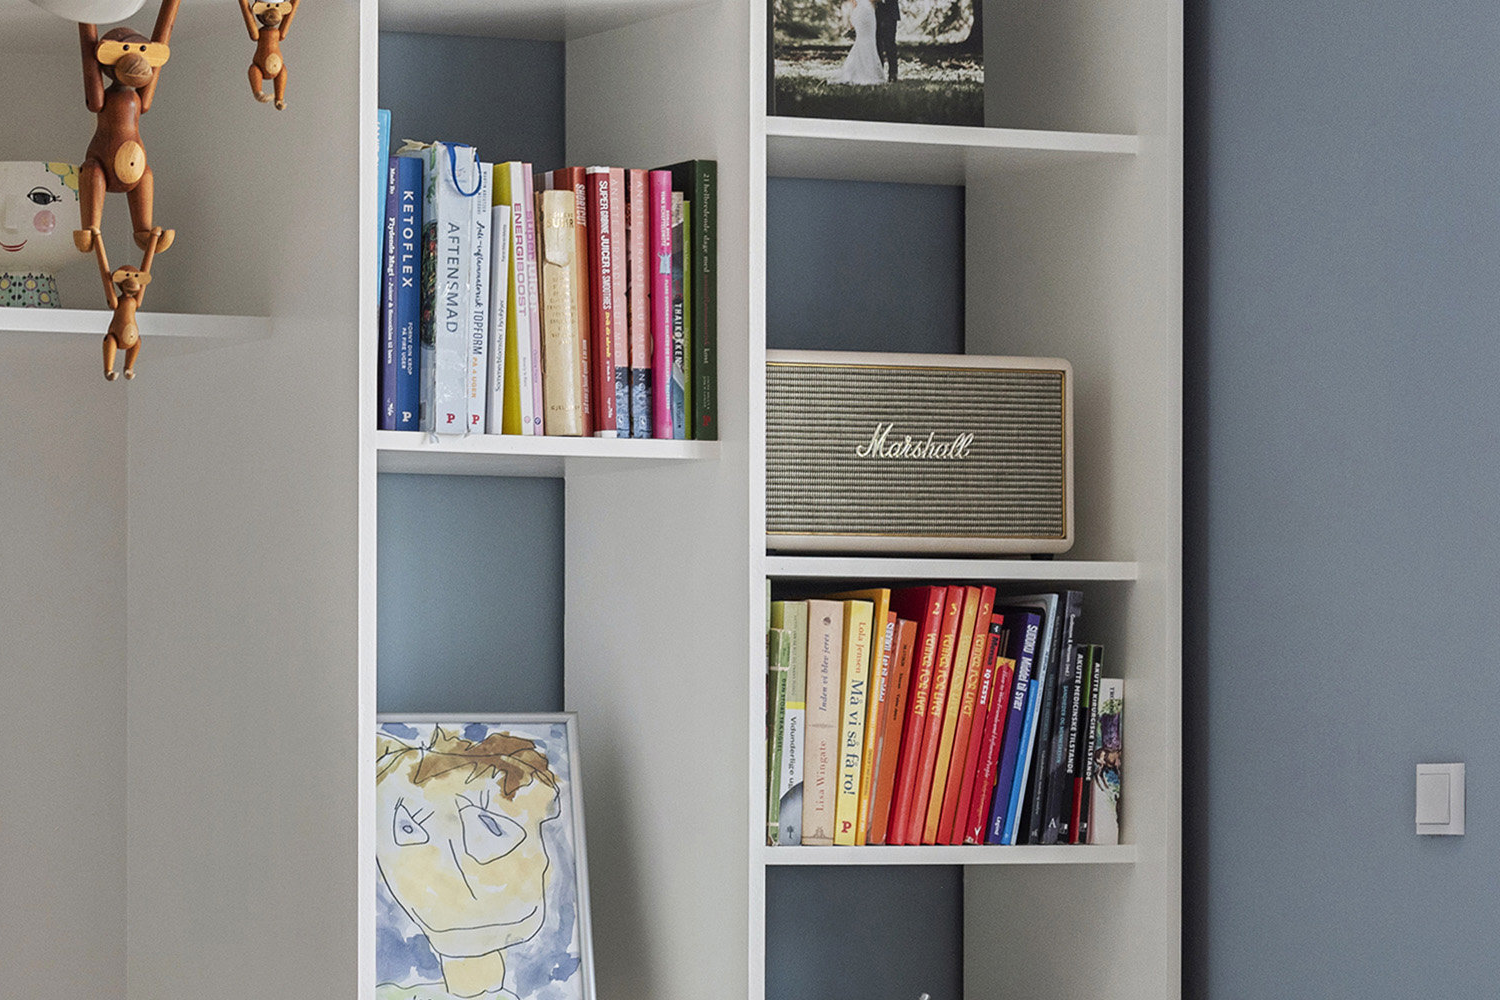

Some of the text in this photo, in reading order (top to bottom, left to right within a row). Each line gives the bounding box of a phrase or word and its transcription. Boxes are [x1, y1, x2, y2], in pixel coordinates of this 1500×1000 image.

[575, 183, 587, 227] SHORTCUT
[636, 180, 644, 229] ANETTE
[388, 217, 396, 254] Flydende
[402, 190, 414, 288] KETOFLEX
[601, 235, 611, 267] JUICER
[702, 235, 710, 253] dage
[387, 255, 396, 276] Magi
[446, 222, 460, 333] AFTENSMAD
[514, 203, 527, 317] ENERGIBOOST
[602, 275, 612, 310] SMOOTHIES
[637, 298, 645, 328] SLUT
[473, 310, 484, 355] TOPFORM
[674, 303, 683, 362] THAIKØKKEN
[856, 422, 975, 459] Marshall
[823, 633, 832, 653] jeres
[1023, 624, 1038, 654] SUDOKU
[821, 655, 830, 673] blev
[984, 668, 992, 680] IQ
[1018, 656, 1032, 682] Middel
[819, 687, 828, 712] Inden
[980, 680, 989, 705] TESTS
[1013, 692, 1025, 711] svær
[1016, 682, 1029, 693] til
[843, 621, 867, 796] Lola Jensen Må vi så få ro!
[1066, 653, 1084, 774] AKUTTE MEDICINSKE TILSTANDE
[1085, 662, 1101, 781] AKUTTE KIRURGISKE TILSTANDE
[786, 716, 797, 776] Vidunderlige
[816, 740, 828, 812] Lisa Wingate
